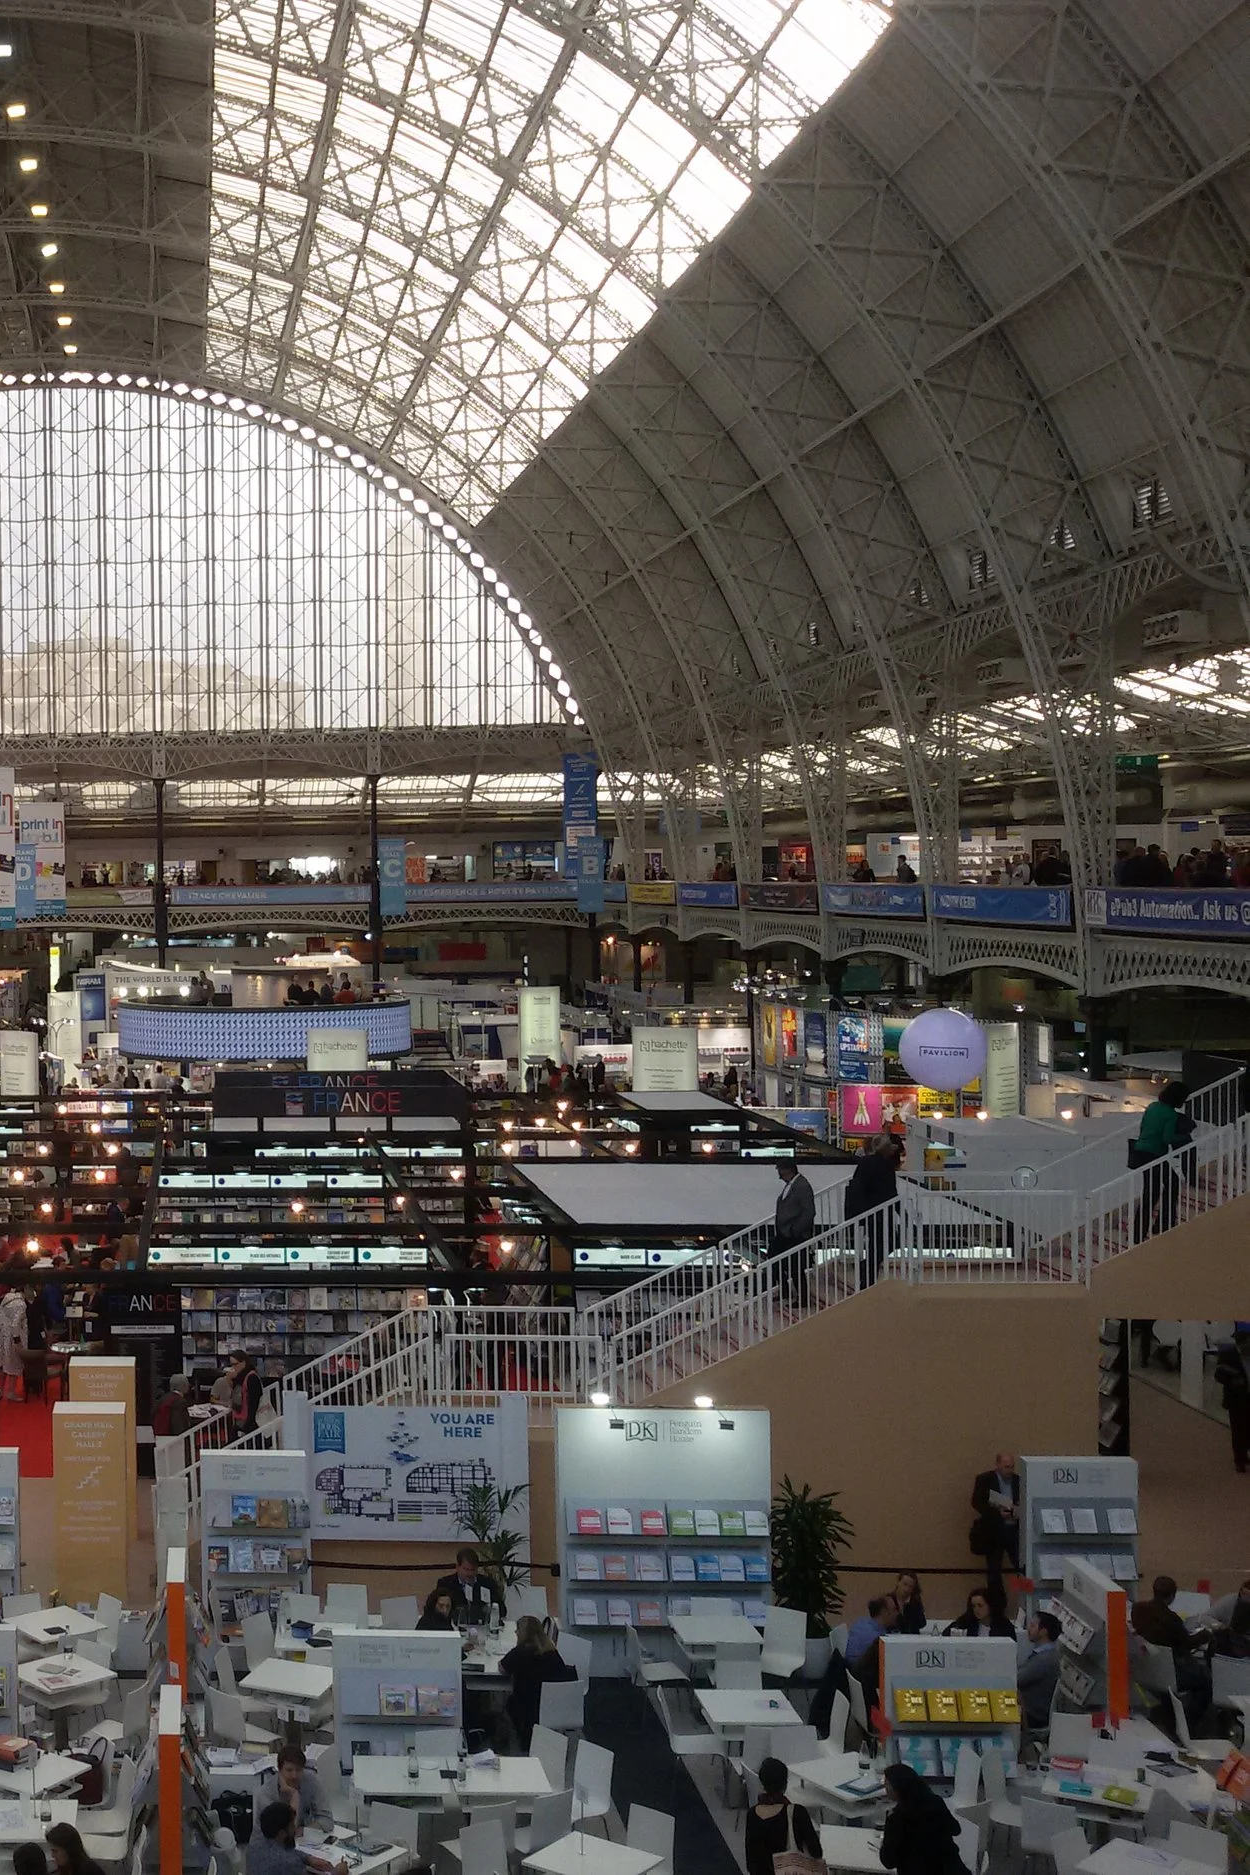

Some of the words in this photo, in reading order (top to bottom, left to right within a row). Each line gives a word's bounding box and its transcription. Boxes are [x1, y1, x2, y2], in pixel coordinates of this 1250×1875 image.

[21, 819, 50, 831] print
[383, 859, 400, 878] C
[1110, 898, 1137, 918] ePub3
[1203, 900, 1222, 921] Ask
[1224, 904, 1239, 921] us
[115, 976, 131, 984] THE
[651, 1039, 688, 1049] hachette
[313, 1091, 401, 1113] FRANCE
[430, 1413, 461, 1425] YOU
[465, 1413, 495, 1425] ARE
[669, 1419, 702, 1429] Penguin
[443, 1427, 483, 1438] HERE
[629, 1421, 655, 1438] DK
[669, 1427, 702, 1436] Random
[669, 1435, 695, 1443] House
[1055, 1468, 1076, 1482] DK
[919, 1650, 943, 1666] DK
